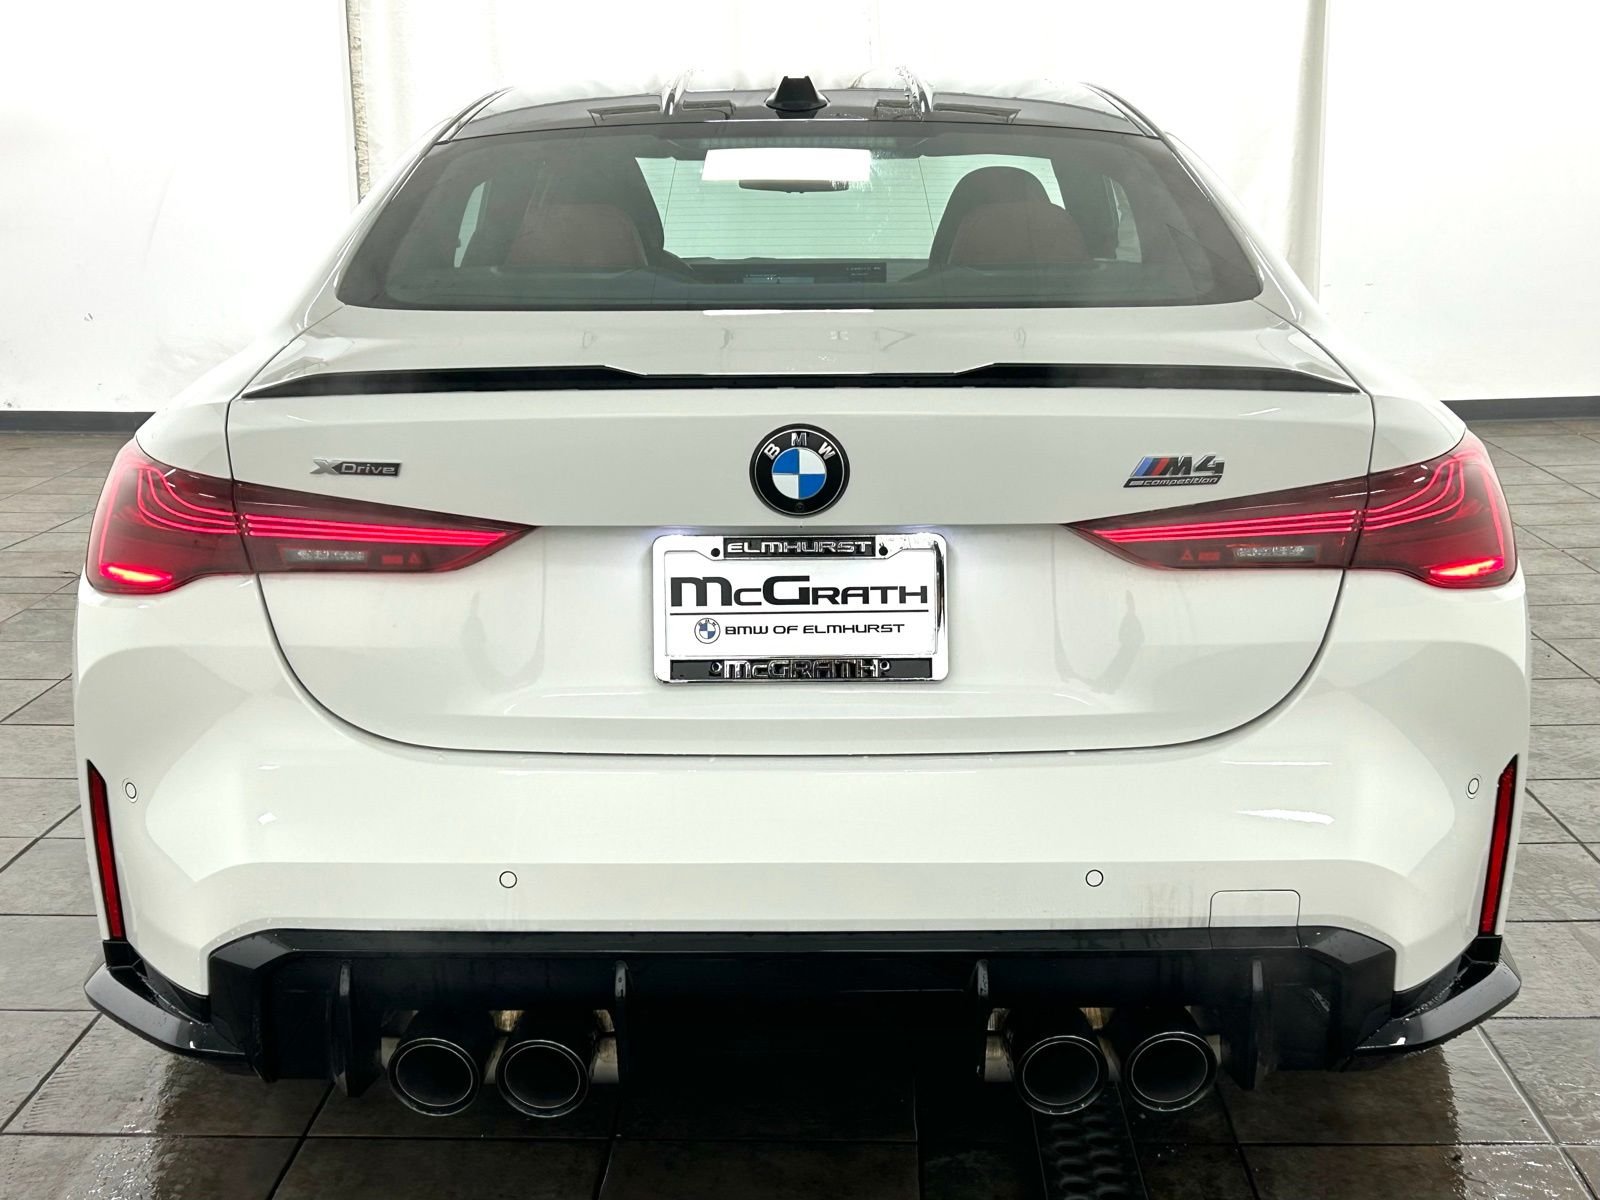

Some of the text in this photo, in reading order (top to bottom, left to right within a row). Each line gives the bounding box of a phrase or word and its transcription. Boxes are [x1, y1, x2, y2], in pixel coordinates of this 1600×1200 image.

[763, 432, 836, 461] BMW
[1159, 455, 1225, 475] M4
[1143, 477, 1218, 486] competition
[727, 541, 872, 553] ELMHURST
[725, 624, 905, 635] BMW OF ELMHURST
